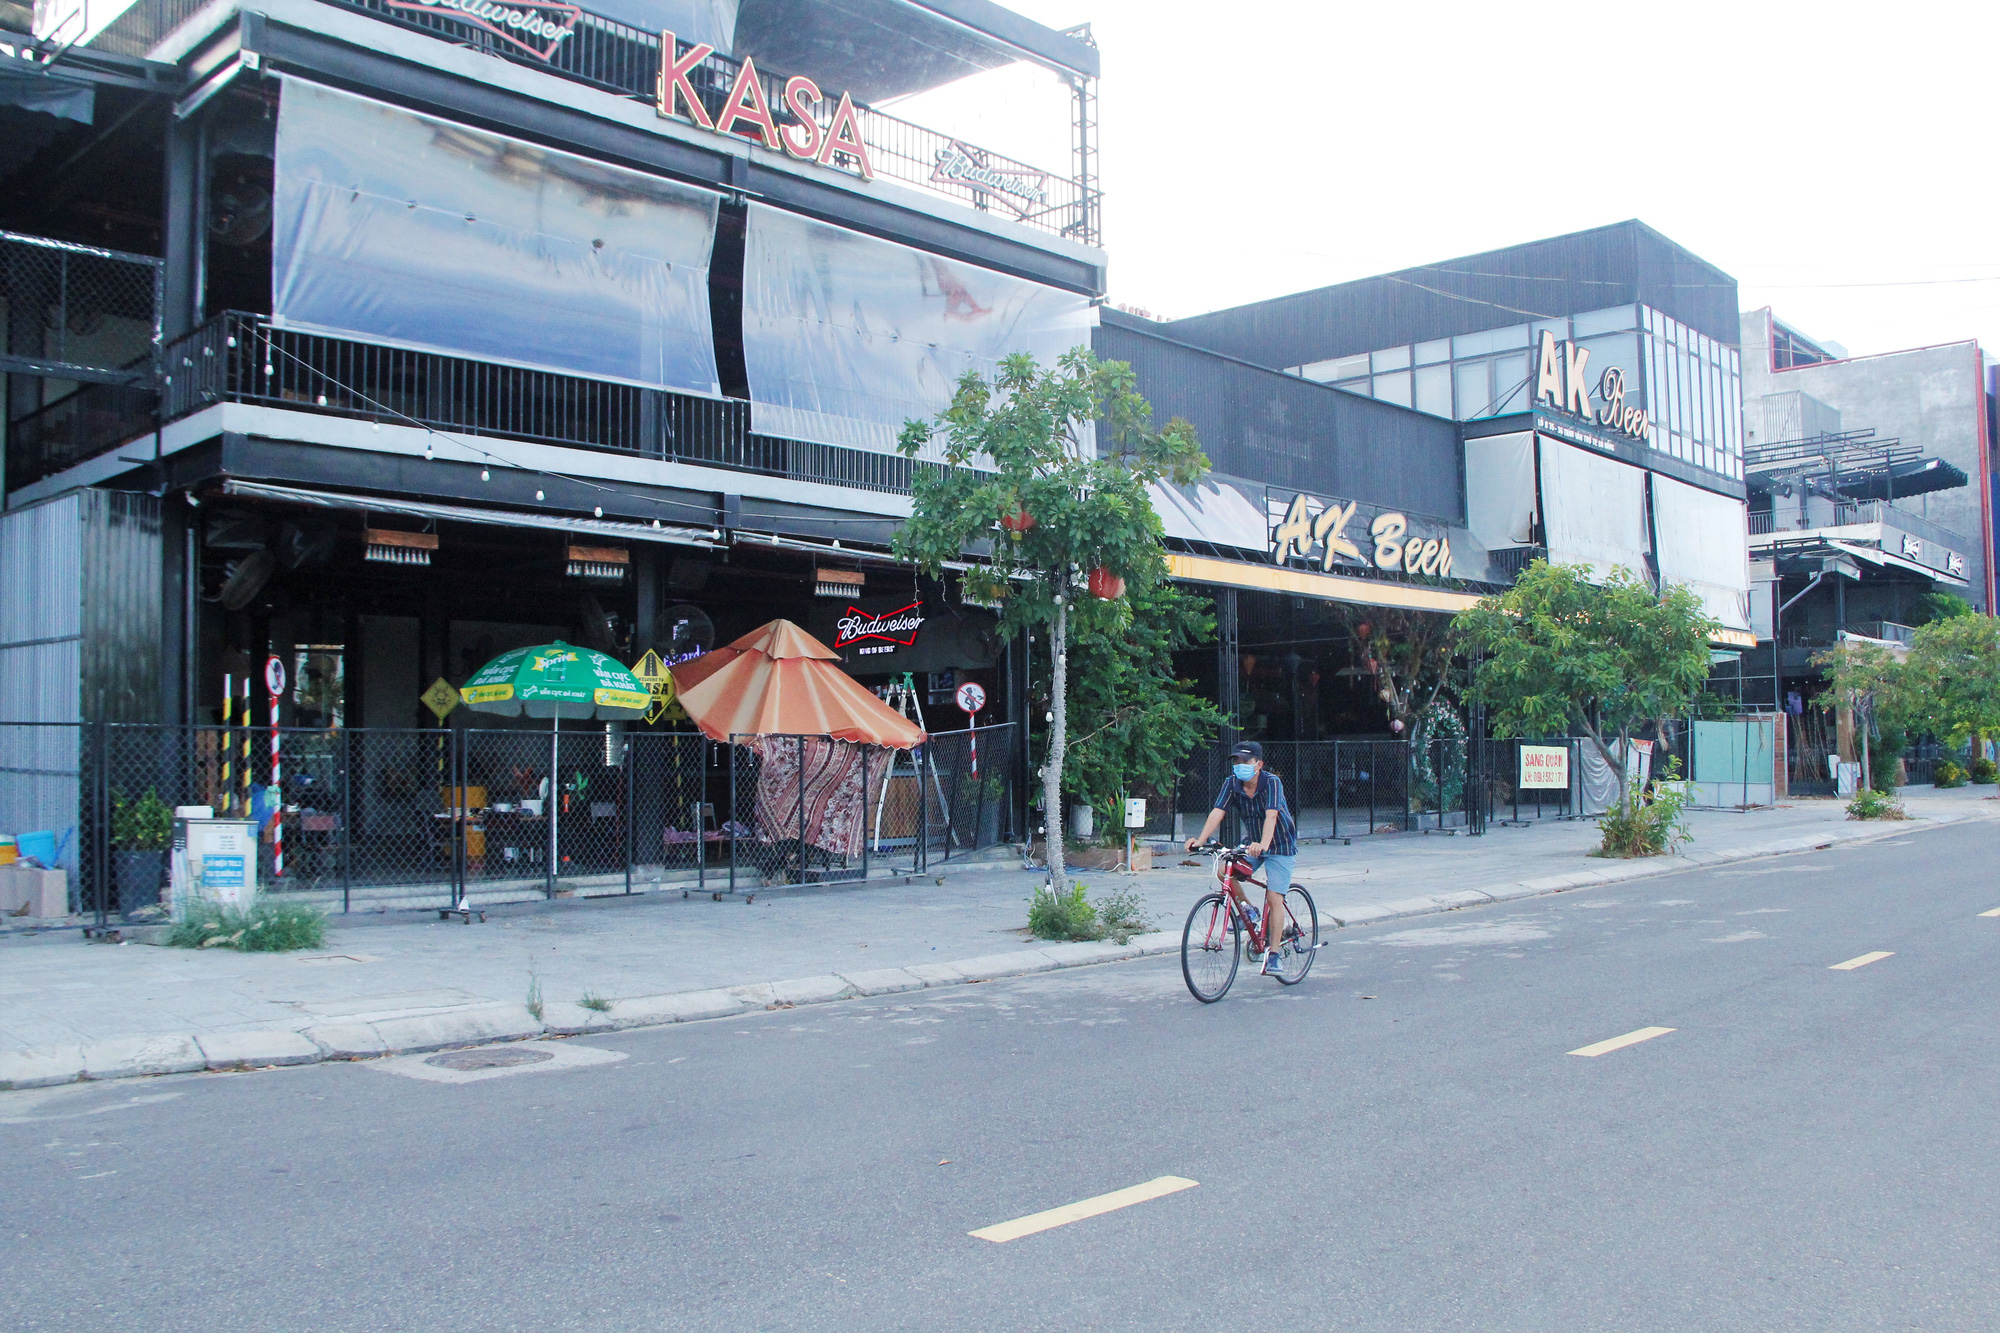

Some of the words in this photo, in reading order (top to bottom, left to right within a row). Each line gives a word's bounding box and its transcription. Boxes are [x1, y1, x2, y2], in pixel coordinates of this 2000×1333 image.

[661, 29, 876, 181] KASA
[936, 147, 1046, 202] Budweiser
[1537, 329, 1592, 419] AK
[1600, 366, 1649, 439] Beer
[1274, 493, 1360, 572] AK
[1369, 512, 1452, 578] Beer
[837, 613, 925, 640] Budweiser
[538, 654, 572, 668] Sprite
[871, 646, 878, 654] OF
[645, 682, 668, 694] ASA
[1525, 753, 1544, 766] SANG
